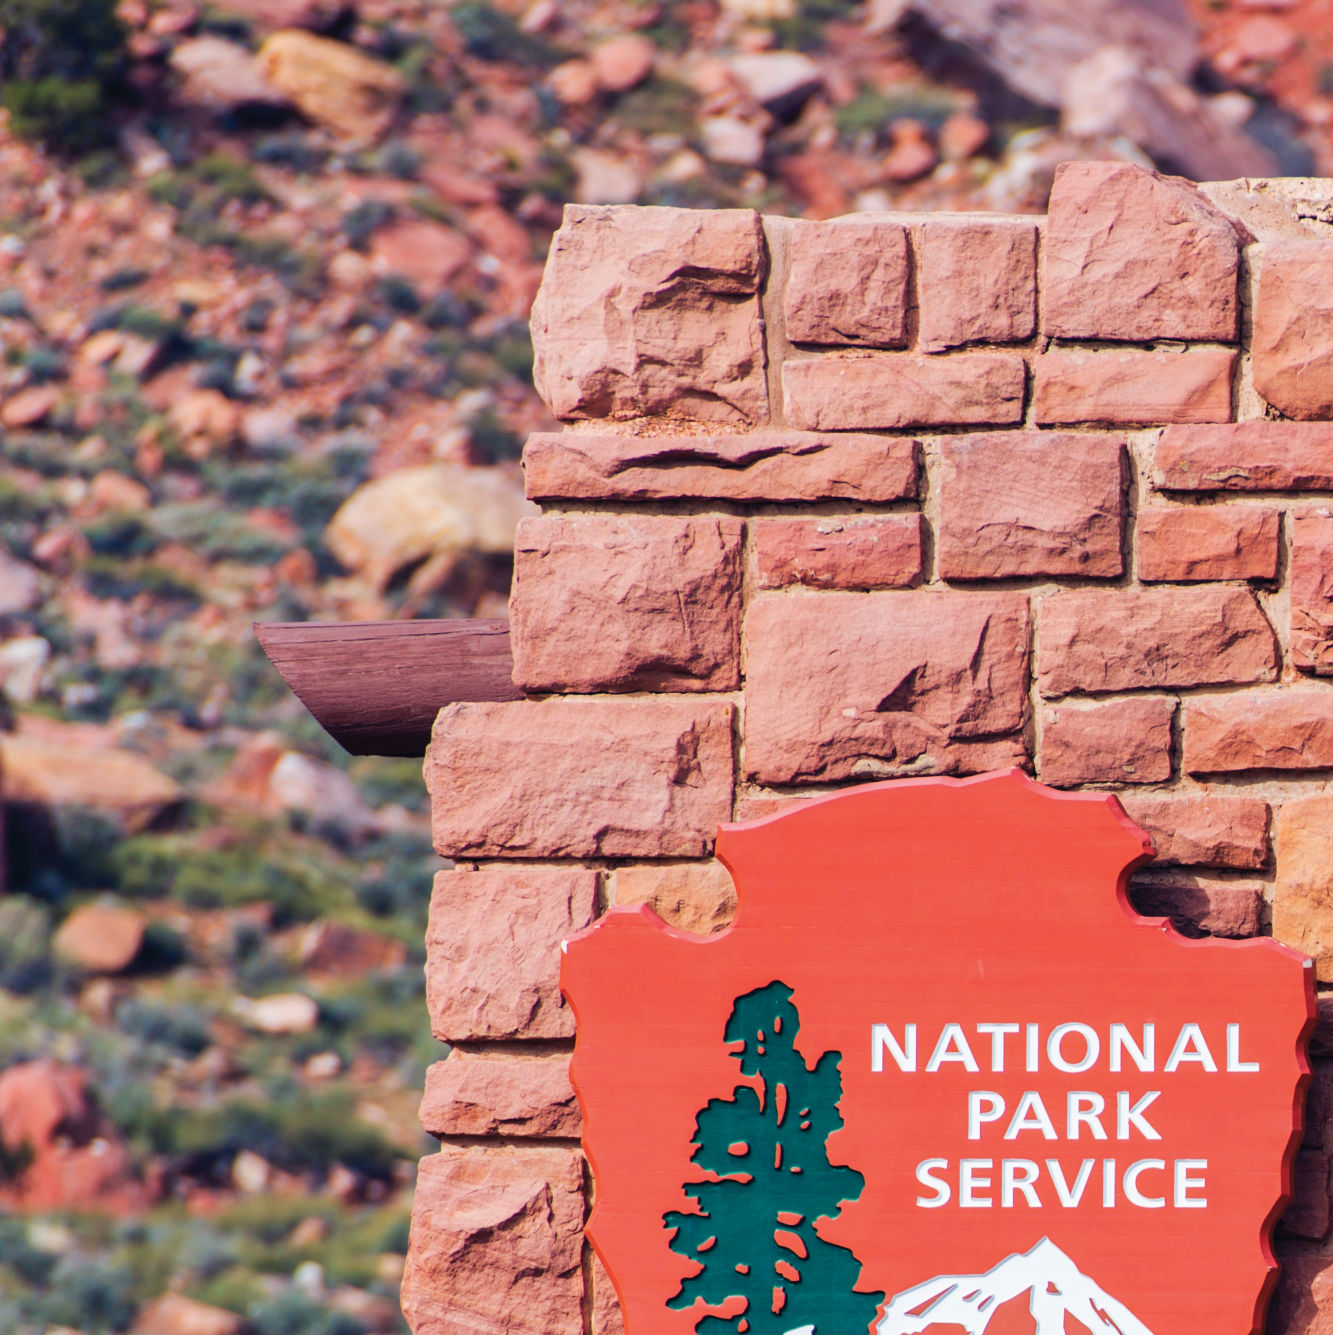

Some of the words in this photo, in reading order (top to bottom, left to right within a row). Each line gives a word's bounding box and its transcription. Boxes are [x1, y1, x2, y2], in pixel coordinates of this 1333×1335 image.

[872, 1021, 1260, 1074] NATIONAL
[967, 1090, 1162, 1141] PARK
[915, 1157, 1208, 1209] SERVICE
